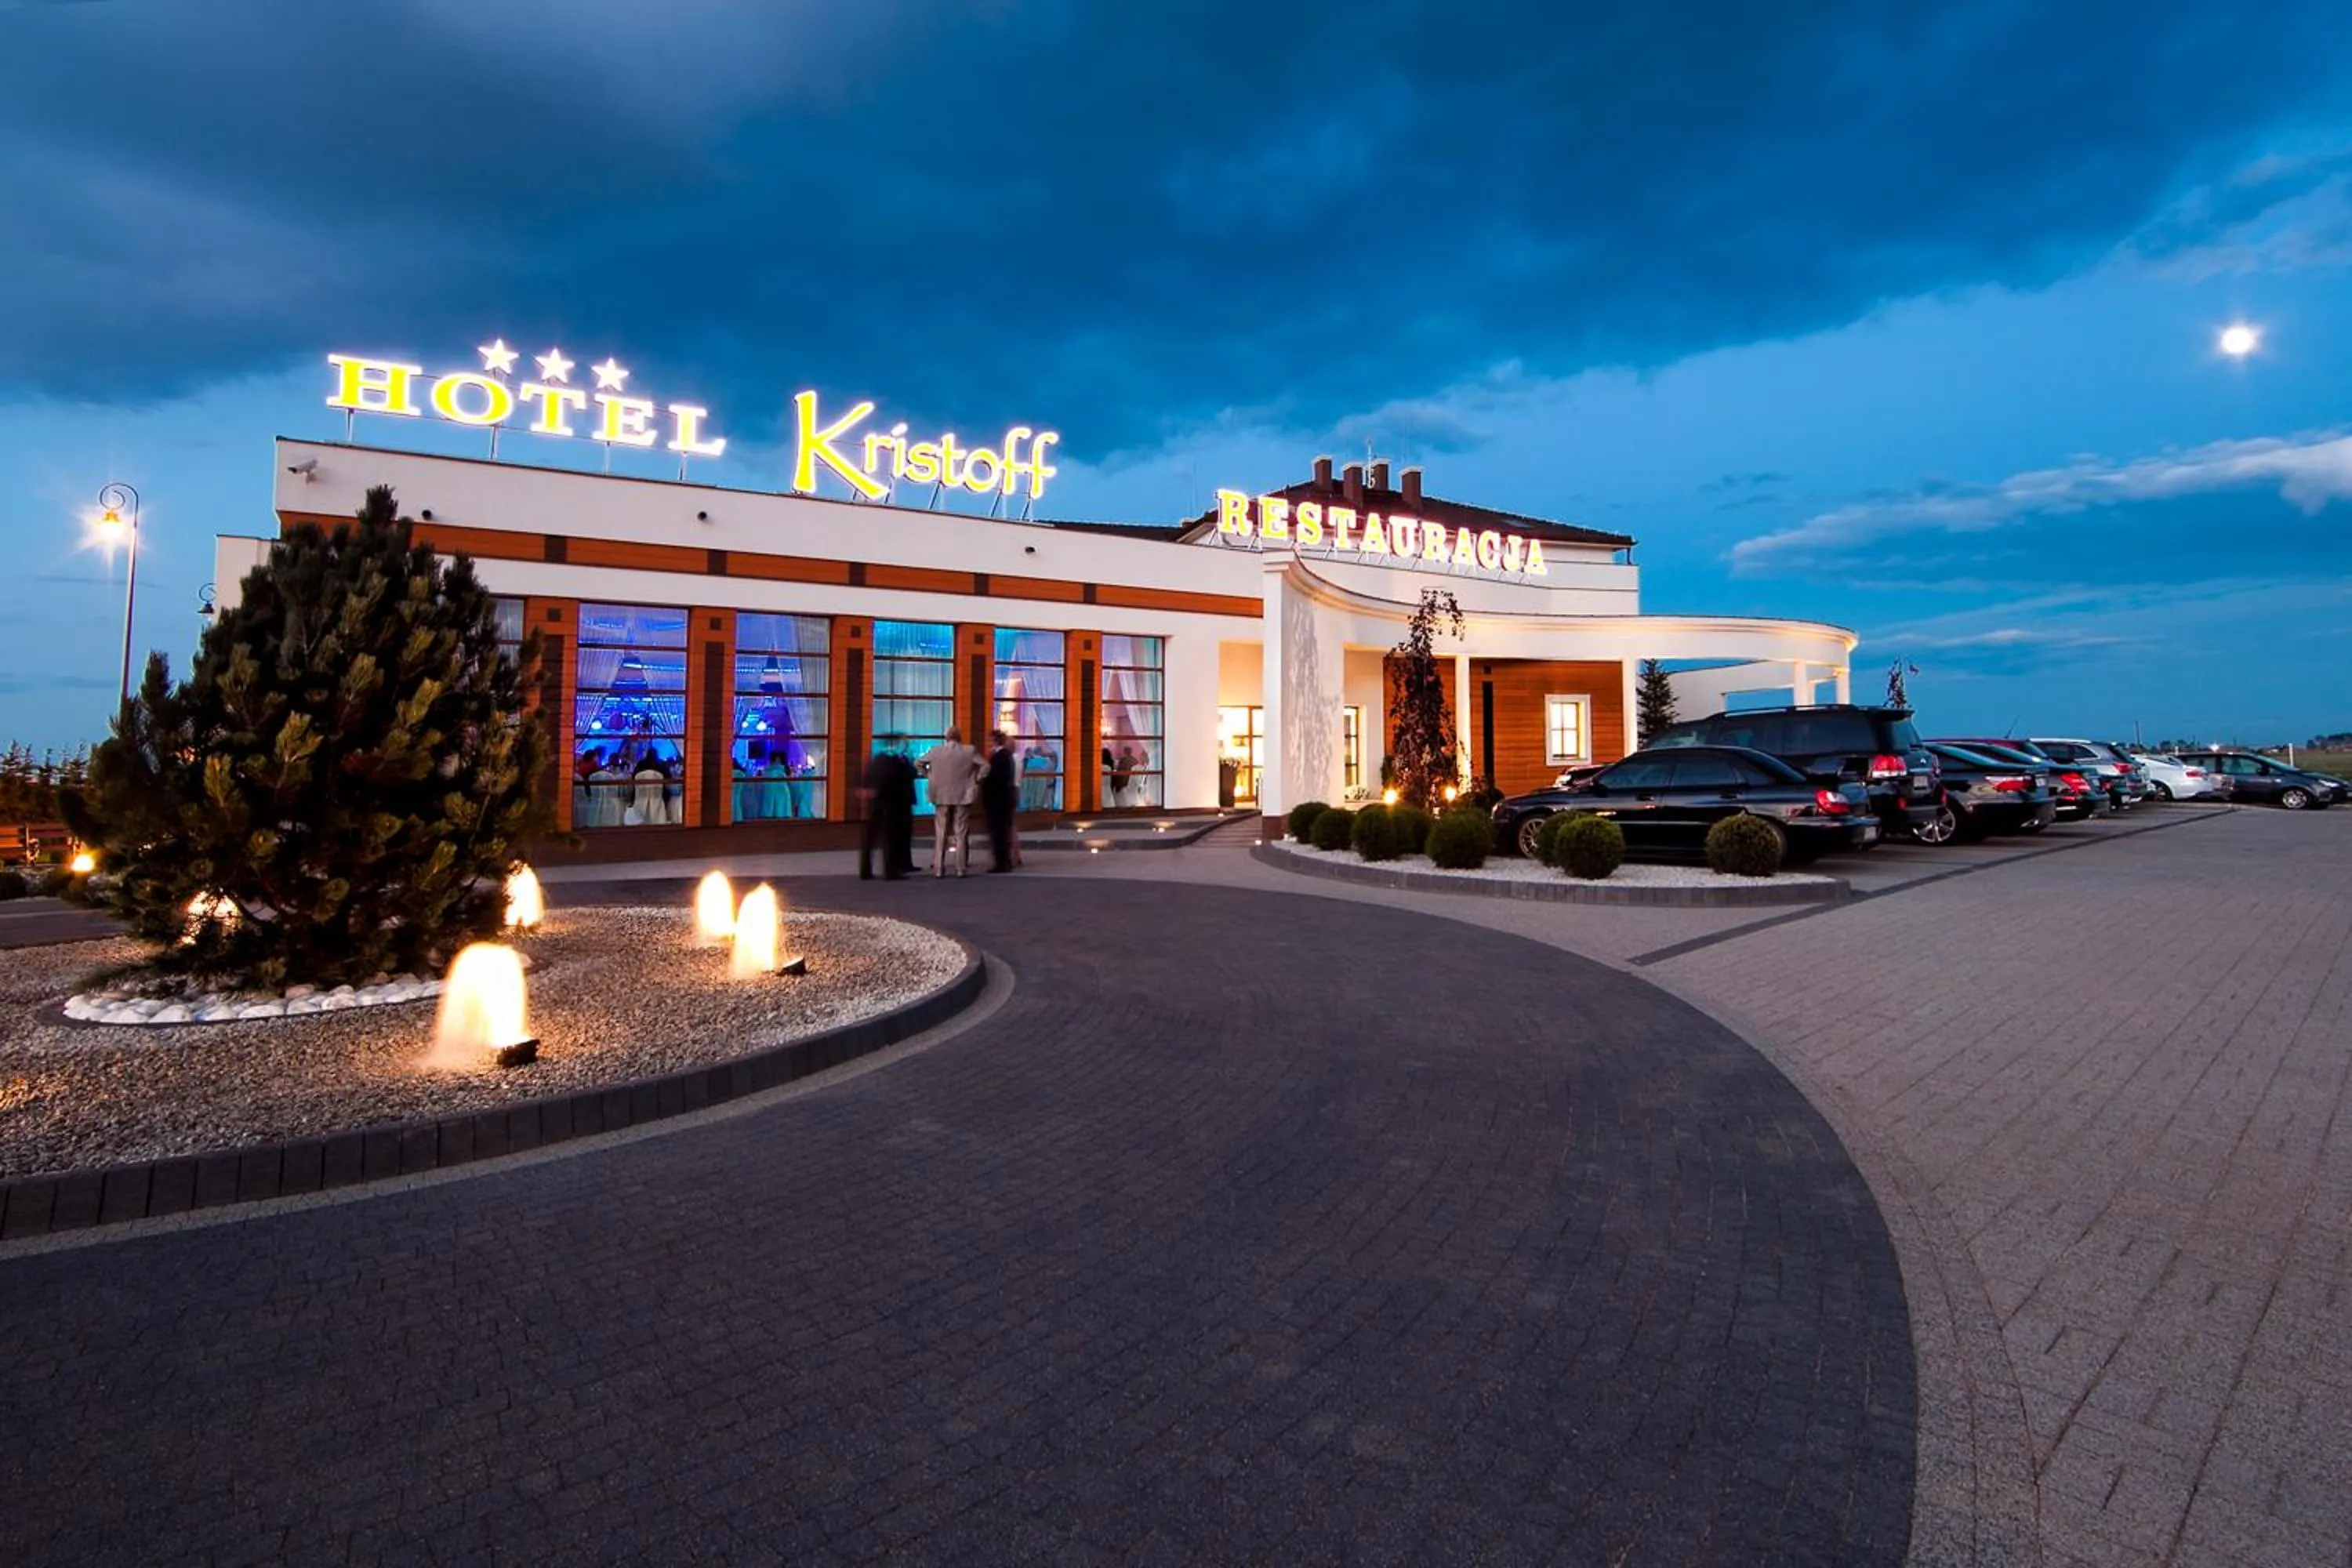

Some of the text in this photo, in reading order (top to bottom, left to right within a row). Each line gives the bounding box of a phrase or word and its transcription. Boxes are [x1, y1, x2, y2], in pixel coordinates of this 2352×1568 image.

[326, 354, 1060, 499] HOTEL Kristoff
[1216, 488, 1548, 575] RESTAURACJA
